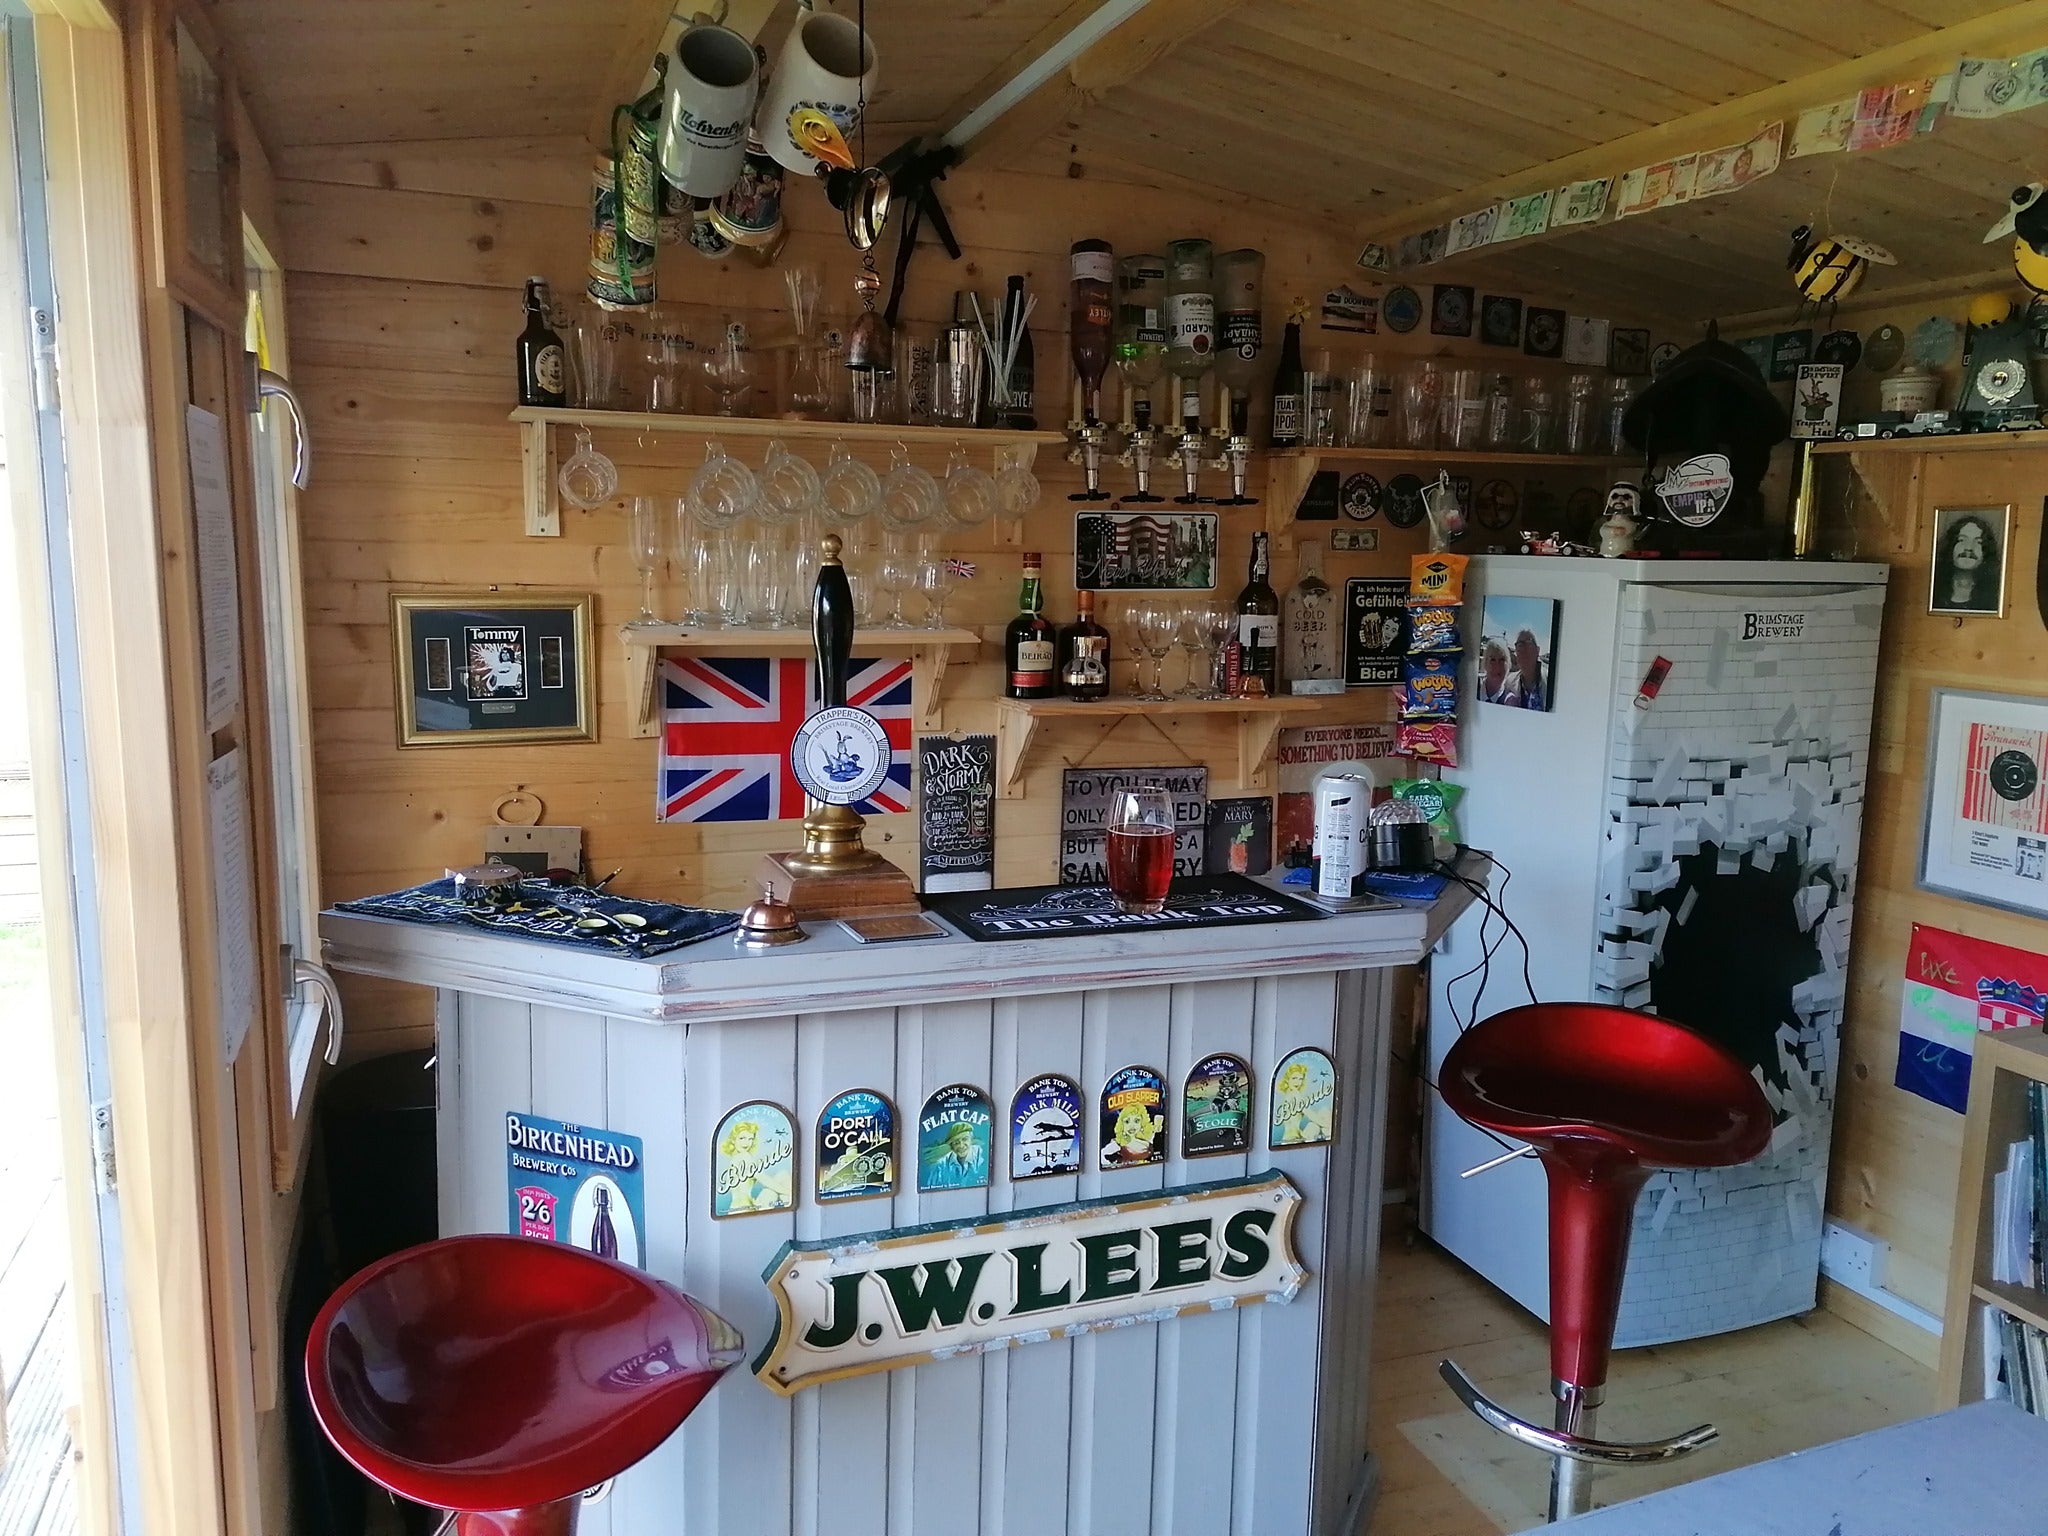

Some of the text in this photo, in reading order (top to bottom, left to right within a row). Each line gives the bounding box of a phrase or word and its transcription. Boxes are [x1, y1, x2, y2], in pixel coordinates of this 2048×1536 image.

[1812, 427, 1833, 437] Hat
[1695, 499, 1715, 513] IPA
[1079, 554, 1187, 580] New York
[1421, 574, 1448, 587] MINI
[1295, 610, 1325, 620] COLD
[1743, 613, 1805, 632] BRIMSTAGE
[1293, 621, 1327, 632] BEER
[469, 628, 520, 643] Tommy
[1360, 666, 1398, 680] Bier!
[816, 710, 876, 729] TRAPPER'S HAT
[1304, 728, 1353, 742] EVERYONE
[923, 745, 988, 776] DARK
[1280, 745, 1338, 765] SOMETHING
[1340, 743, 1354, 761] TO
[936, 765, 984, 796] STORMY
[1068, 780, 1092, 796] TO
[1165, 777, 1204, 793] MAY
[1066, 808, 1106, 824] ONLY
[1225, 809, 1254, 822] MARY
[1066, 838, 1097, 855] BUT
[983, 904, 1284, 931] The Bank Top
[1203, 1059, 1234, 1071] BANK TOP
[1116, 1069, 1153, 1083] BANK TOP
[935, 1087, 978, 1102] BANK TOP
[1028, 1078, 1068, 1094] BANK TOP
[836, 1093, 880, 1109] BANK TOP
[1107, 1091, 1160, 1109] OLD SLAPPER
[1273, 1080, 1333, 1126] Blonde
[1016, 1098, 1080, 1126] DARK MILD
[561, 1122, 580, 1133] THE
[830, 1115, 874, 1133] PORT
[922, 1109, 990, 1133] FLAT CAP
[507, 1115, 636, 1168] BIRKENHEAD
[824, 1130, 891, 1149] O'CALL
[512, 1153, 559, 1174] BREWERY
[717, 1138, 793, 1195] Blonde
[521, 1195, 551, 1224] 2/6
[525, 1222, 537, 1230] PER
